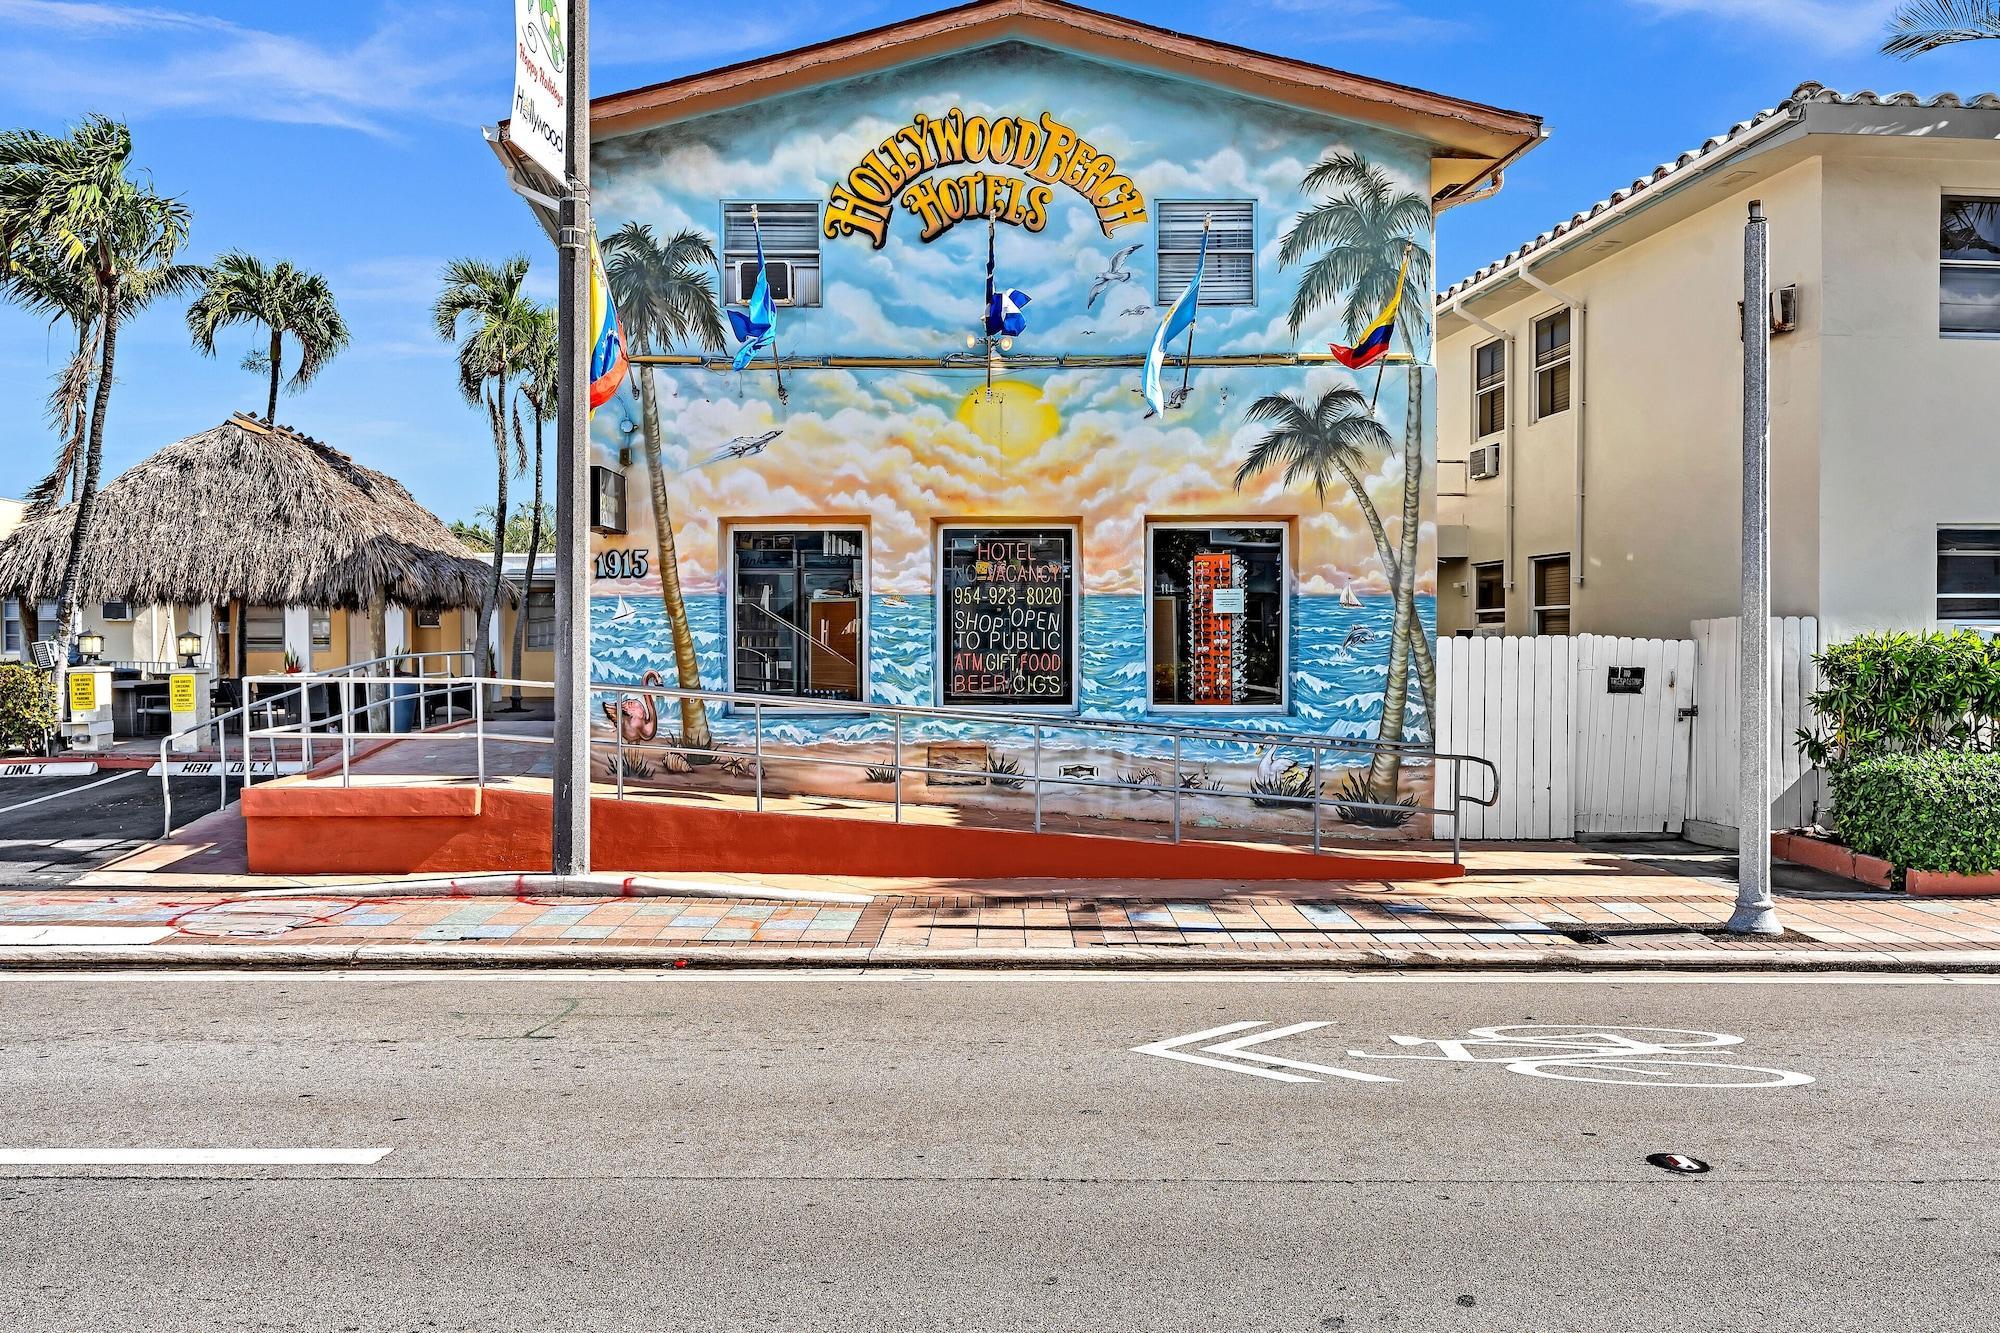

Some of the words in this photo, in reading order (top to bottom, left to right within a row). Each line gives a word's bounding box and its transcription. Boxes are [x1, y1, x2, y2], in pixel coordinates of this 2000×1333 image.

[520, 43, 538, 82] Happy
[824, 107, 1042, 250] HOLLYWOOD
[1025, 111, 1148, 240] BEACH
[901, 171, 1053, 243] HOTELS
[978, 543, 1037, 560] HOTEL
[595, 549, 648, 579] 1915
[954, 565, 978, 583] NO
[987, 564, 1061, 583] VACANCY
[954, 587, 1062, 605] 954-923-8020
[954, 610, 1004, 633] SHOP
[1011, 608, 1060, 631] OPEN
[955, 631, 980, 650] TO
[990, 631, 1060, 650] PUBLIC
[1013, 675, 1060, 693] CIGS
[4, 764, 47, 776] ONLY
[182, 762, 213, 773] HBH
